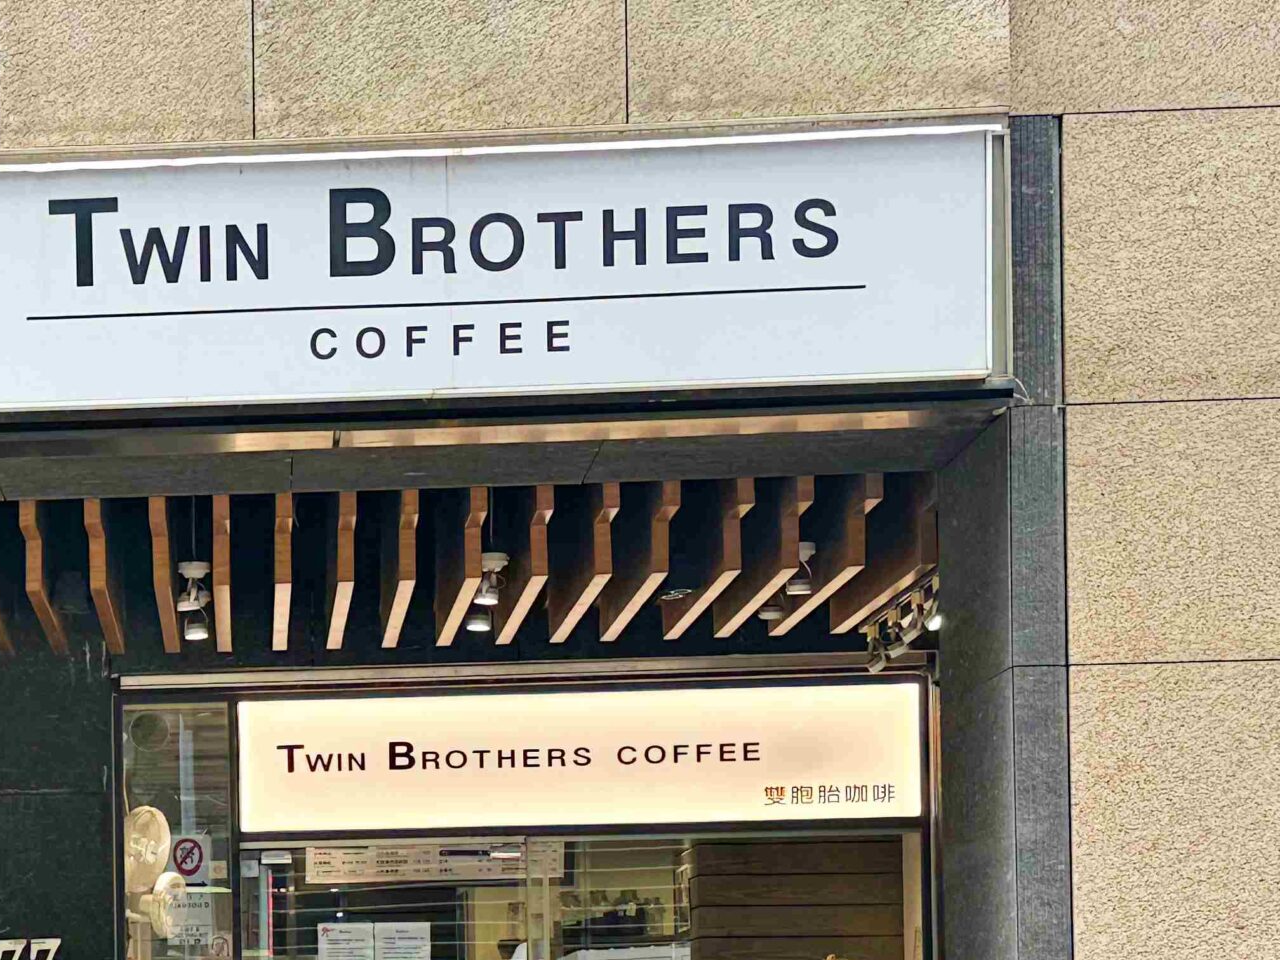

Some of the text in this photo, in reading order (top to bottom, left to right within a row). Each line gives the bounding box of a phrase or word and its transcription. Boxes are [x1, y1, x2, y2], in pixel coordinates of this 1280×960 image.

[48, 187, 840, 287] TWIN BROTHERS
[310, 320, 570, 360] COFFEE
[276, 741, 761, 774] TWIN BROTHERS COFFEE
[764, 784, 896, 806] 雙胞胎咖啡
